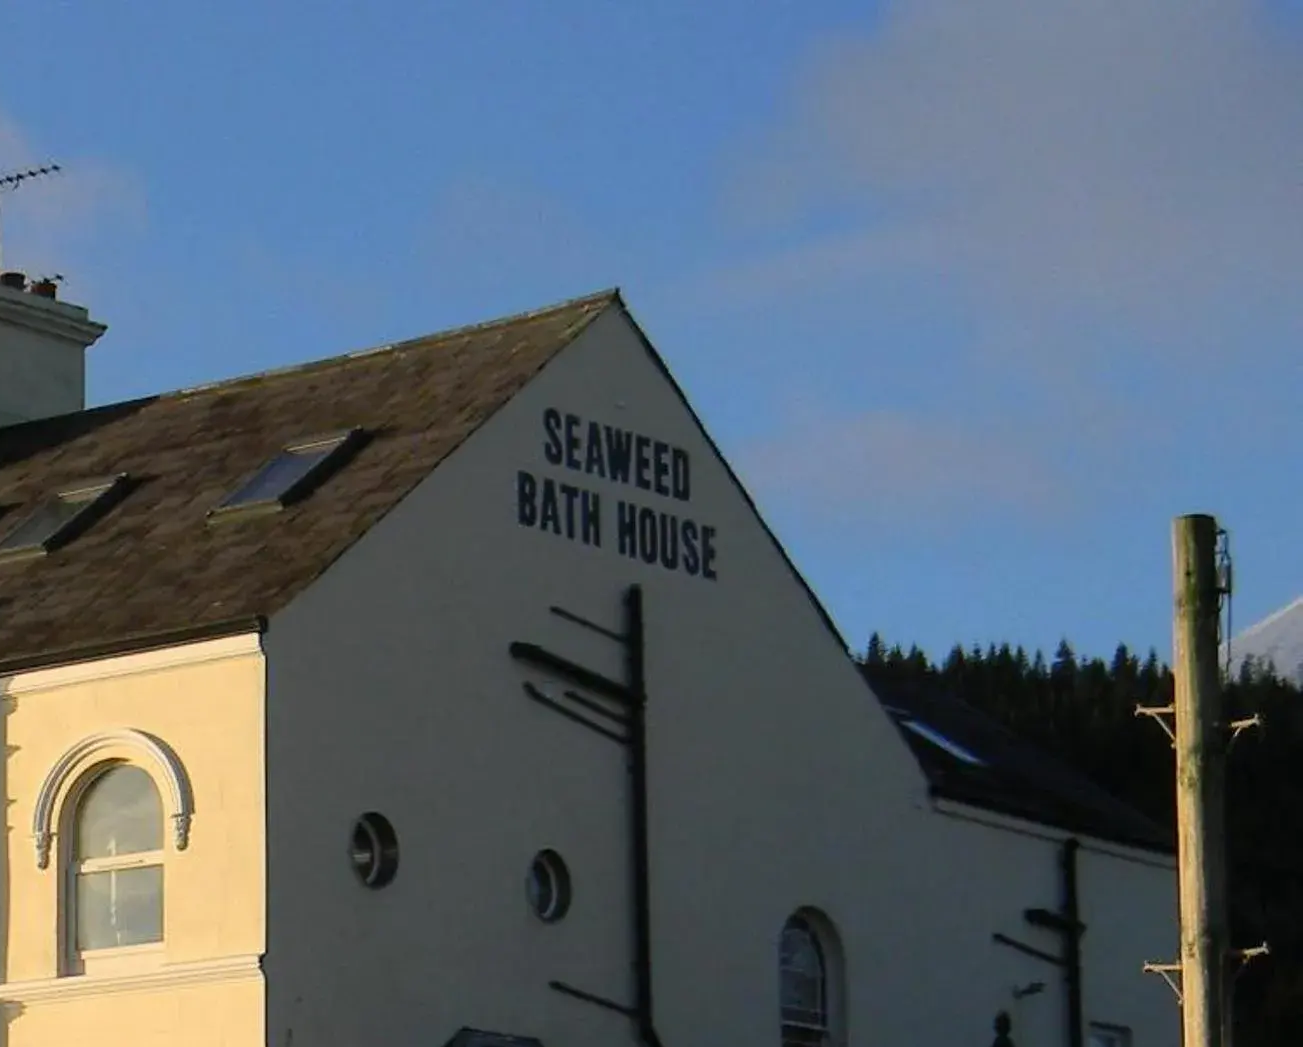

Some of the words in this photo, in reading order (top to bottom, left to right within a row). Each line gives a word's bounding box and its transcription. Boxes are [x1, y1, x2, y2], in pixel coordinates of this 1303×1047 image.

[543, 407, 690, 501] SEAWEED
[517, 470, 601, 548] BATH
[618, 501, 717, 580] HOUSE
